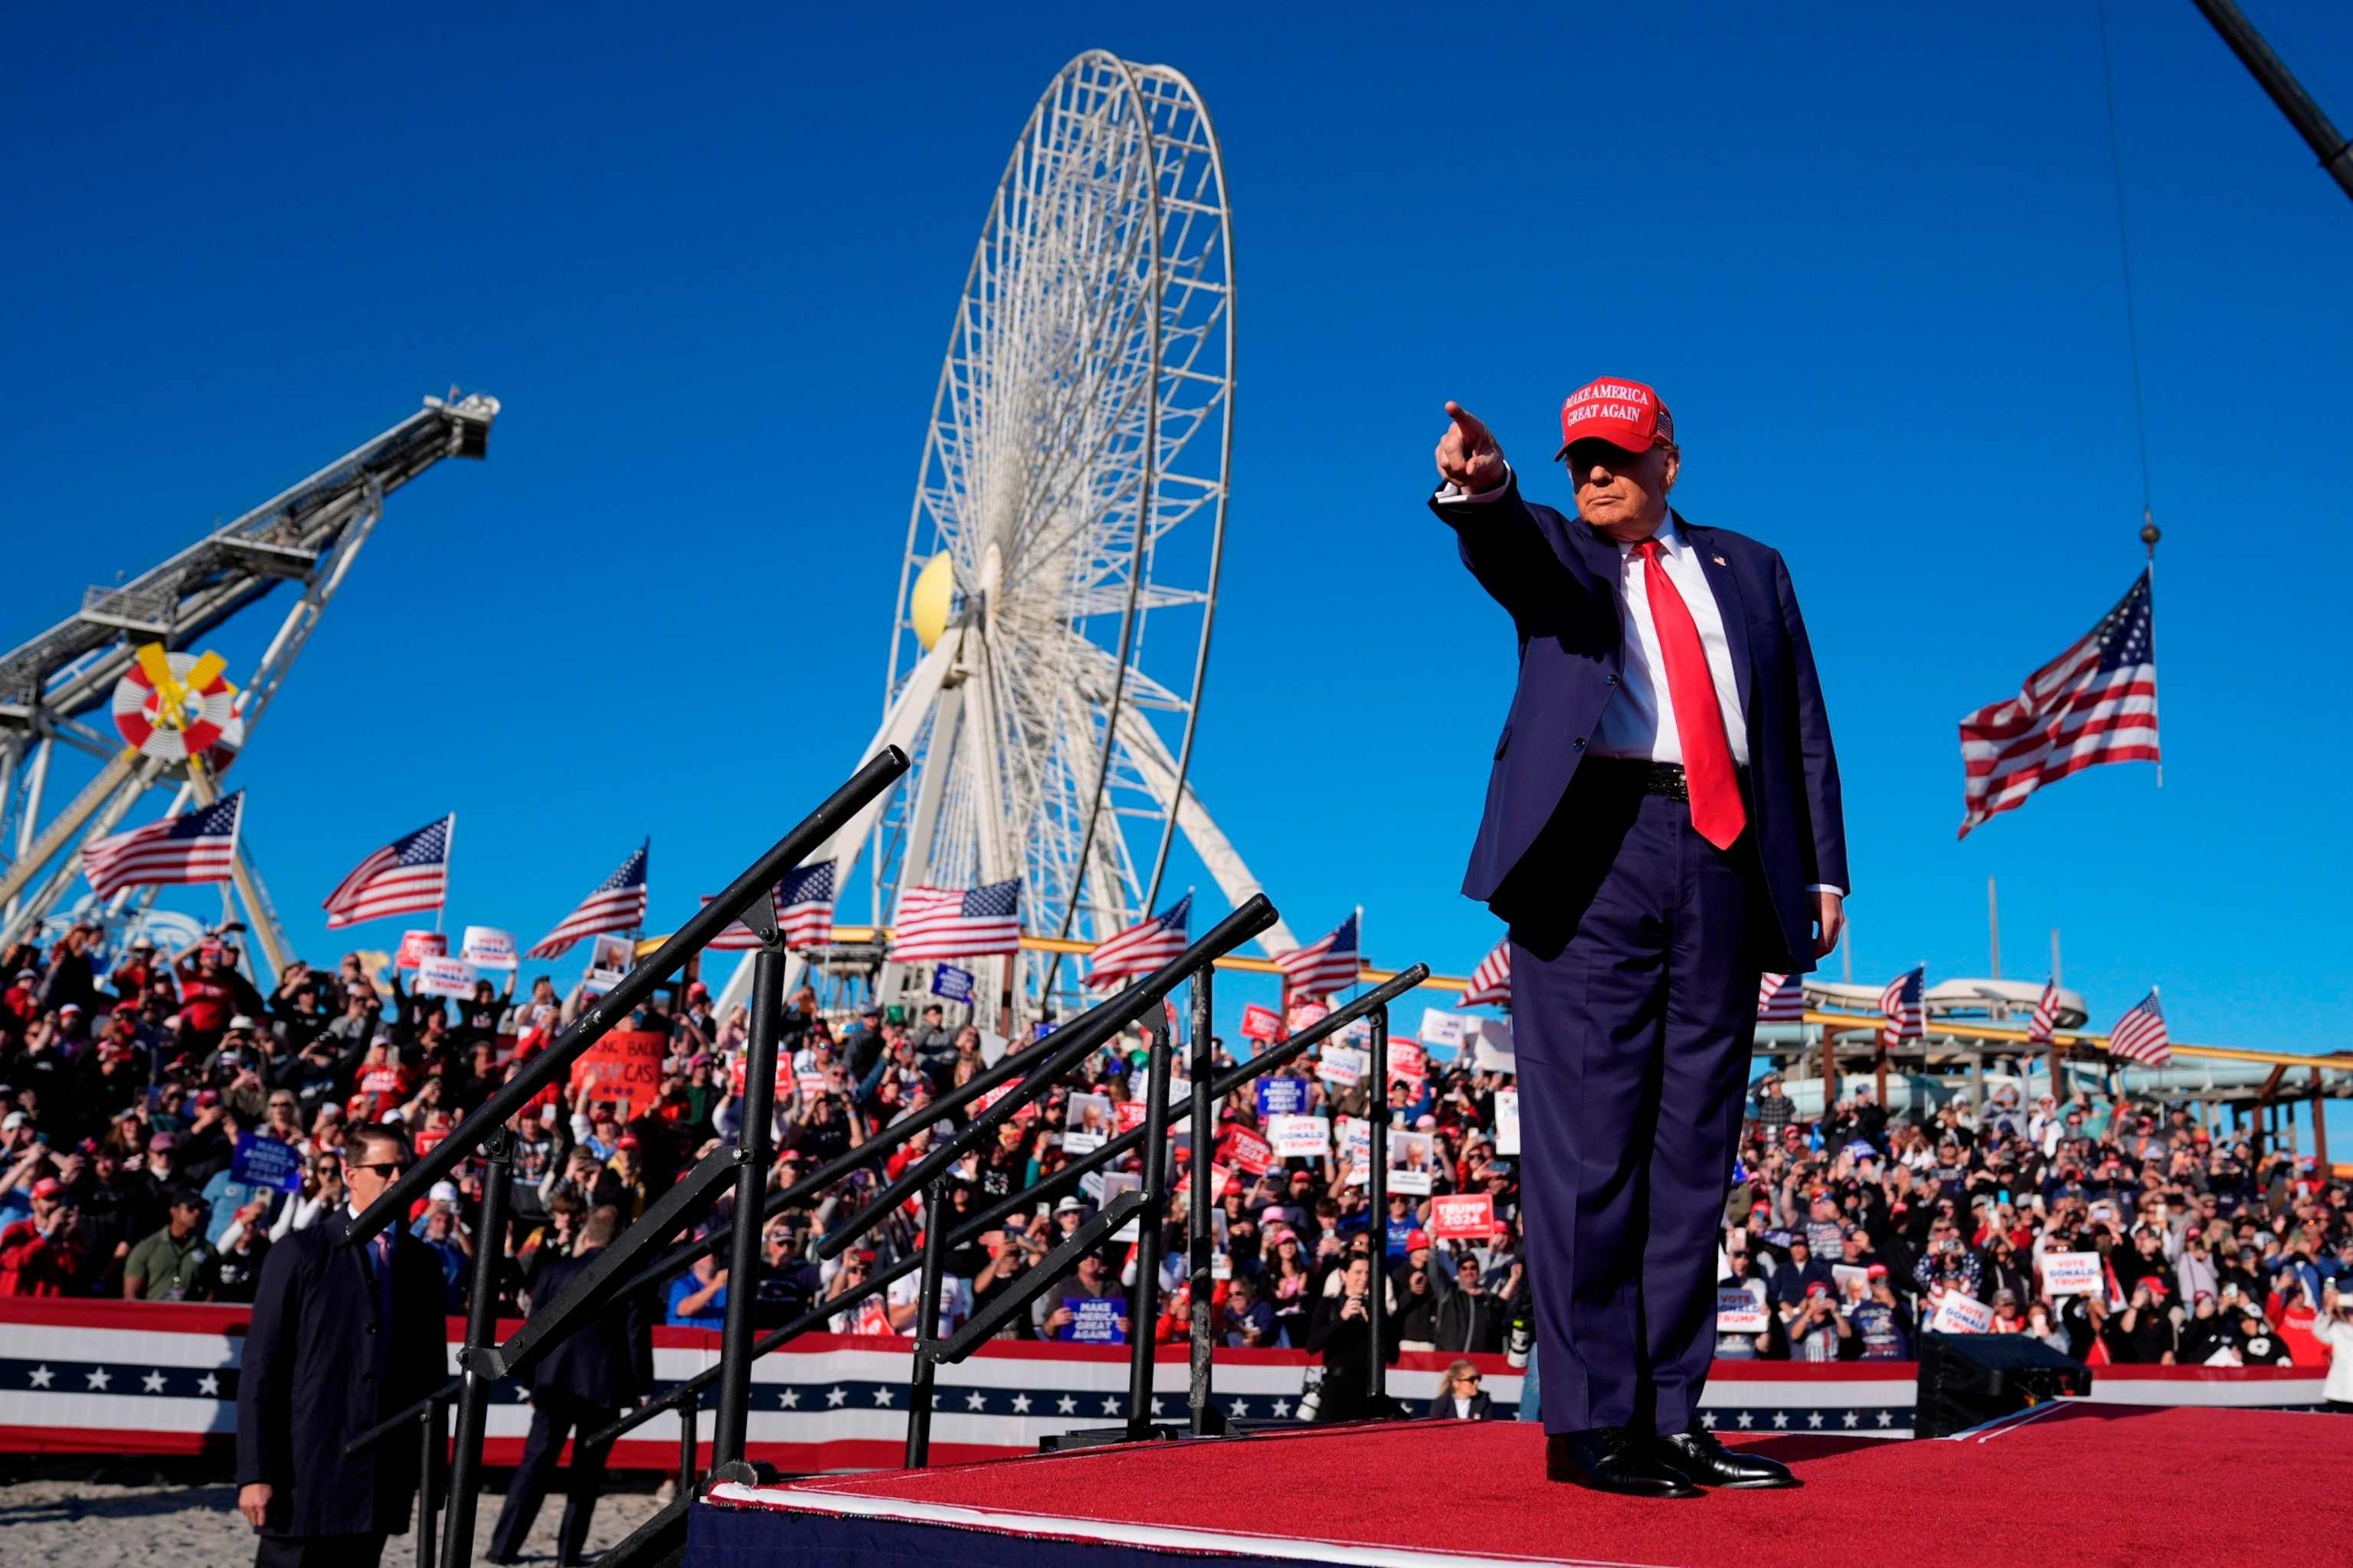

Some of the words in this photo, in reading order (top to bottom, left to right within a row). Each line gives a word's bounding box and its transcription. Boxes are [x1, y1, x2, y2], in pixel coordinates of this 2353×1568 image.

[1564, 388, 1591, 411] MAKE
[1591, 385, 1648, 405] AMERICA
[1568, 404, 1599, 427] GREAT
[1600, 404, 1641, 423] AGAIN
[479, 937, 505, 945] VOTE
[470, 944, 512, 954] DONALD
[435, 961, 463, 974] VOTE
[425, 971, 470, 983] DONALD
[429, 978, 466, 990] TRUMP
[1262, 1088, 1302, 1096] AMERICA
[1120, 1105, 1147, 1115] TRU
[1235, 1132, 1270, 1154] TRUMP
[243, 1148, 295, 1167] AMERICA
[1438, 1203, 1487, 1215] TRUMP
[1444, 1213, 1481, 1226] 2024
[2057, 1259, 2086, 1268] VOTE
[2049, 1268, 2095, 1278] DONALD
[2054, 1277, 2093, 1286] TRUMP
[1721, 1295, 1752, 1304] VOTE
[1079, 1302, 1112, 1312] MAKE
[1959, 1303, 1985, 1319] VOTE
[1946, 1308, 1986, 1330] DONALD
[1075, 1321, 1113, 1330] GREAT
